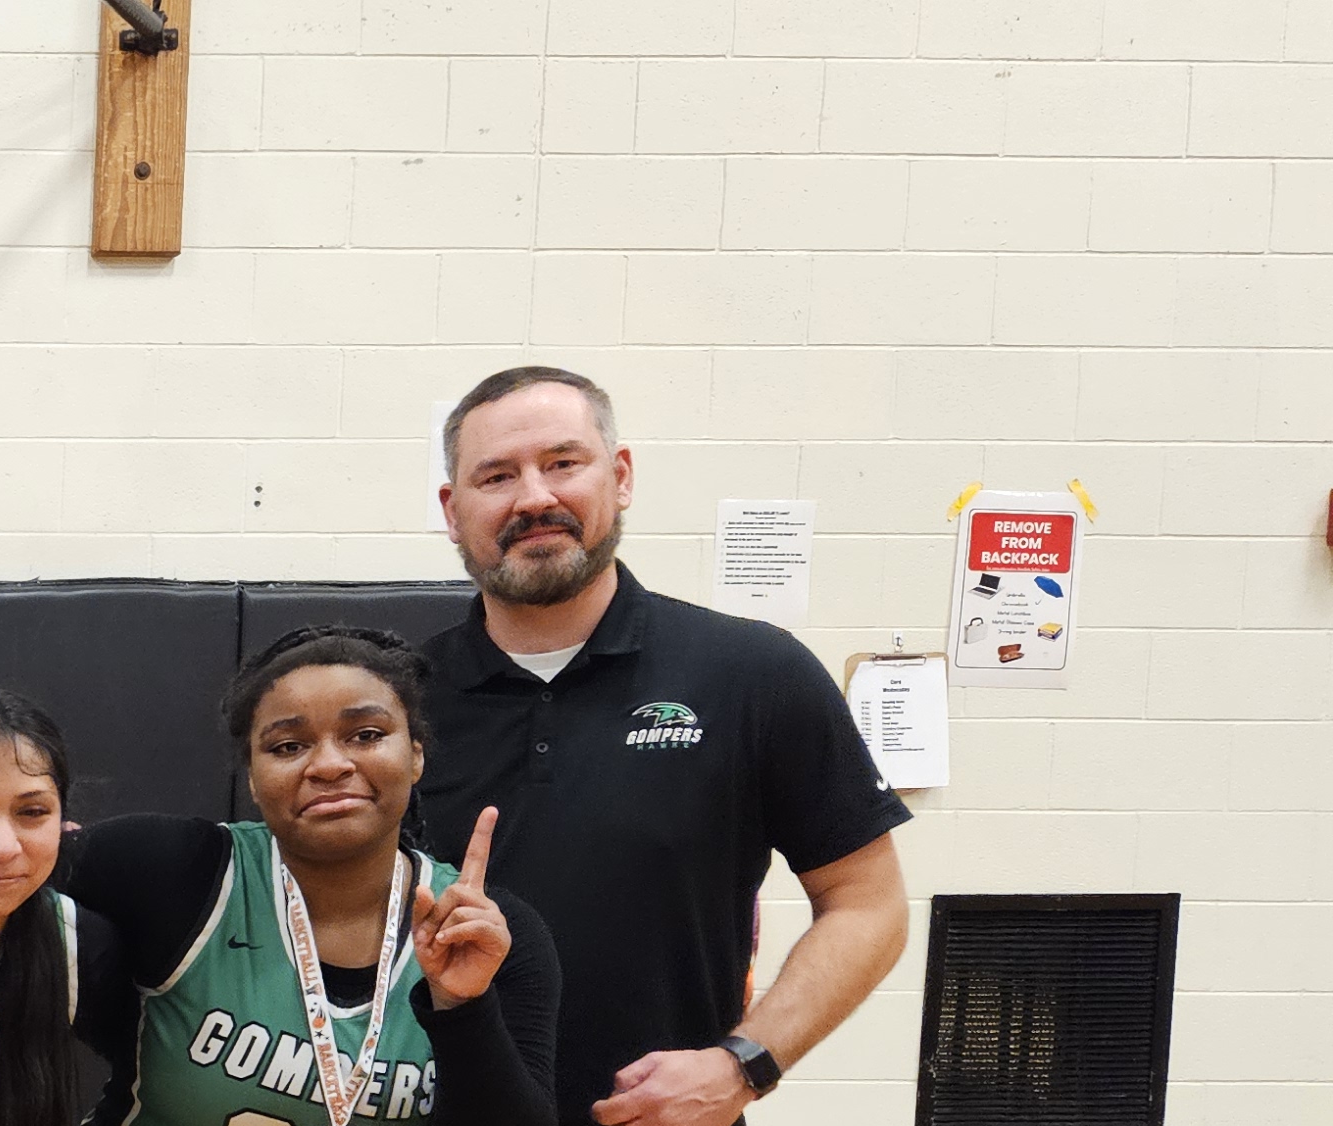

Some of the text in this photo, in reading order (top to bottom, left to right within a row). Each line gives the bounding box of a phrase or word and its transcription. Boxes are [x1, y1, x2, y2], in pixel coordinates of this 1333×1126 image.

[994, 521, 1052, 534] REMOVE
[1001, 537, 1042, 549] FROM
[981, 551, 1059, 565] BACKPACK
[626, 727, 703, 745] GOMPERS
